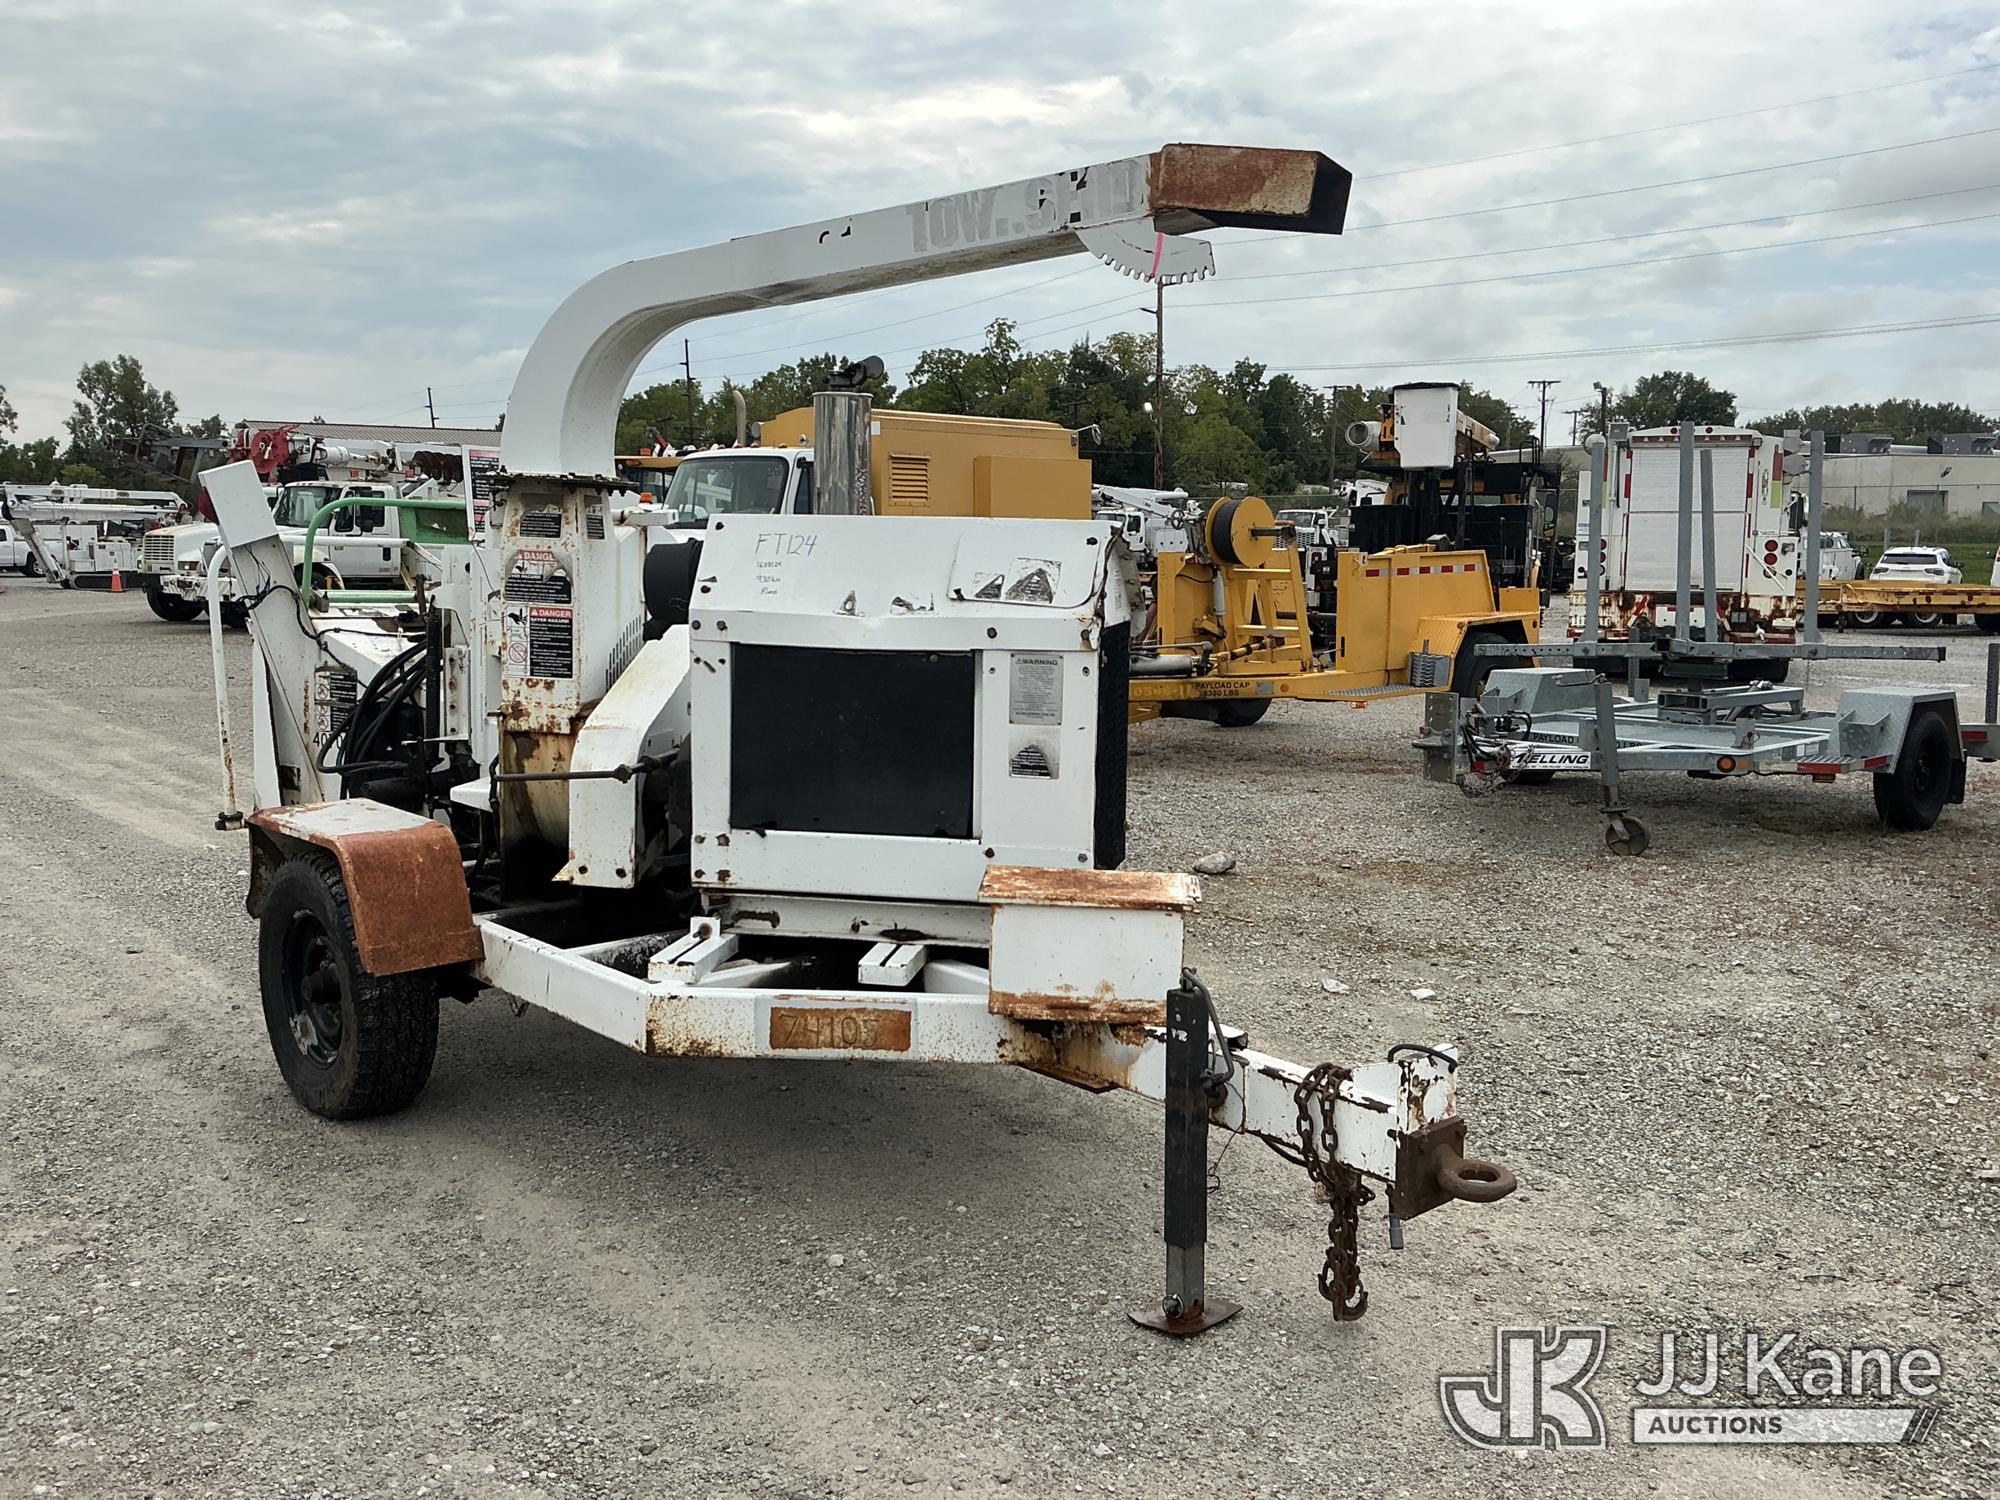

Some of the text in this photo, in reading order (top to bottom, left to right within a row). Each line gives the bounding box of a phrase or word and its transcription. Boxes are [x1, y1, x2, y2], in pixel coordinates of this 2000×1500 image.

[755, 533, 817, 556] FT124
[539, 609, 571, 618] DANGER
[1022, 658, 1058, 666] WARNING
[1223, 689, 1240, 697] LBS
[1533, 733, 1574, 744] PAYLOAD
